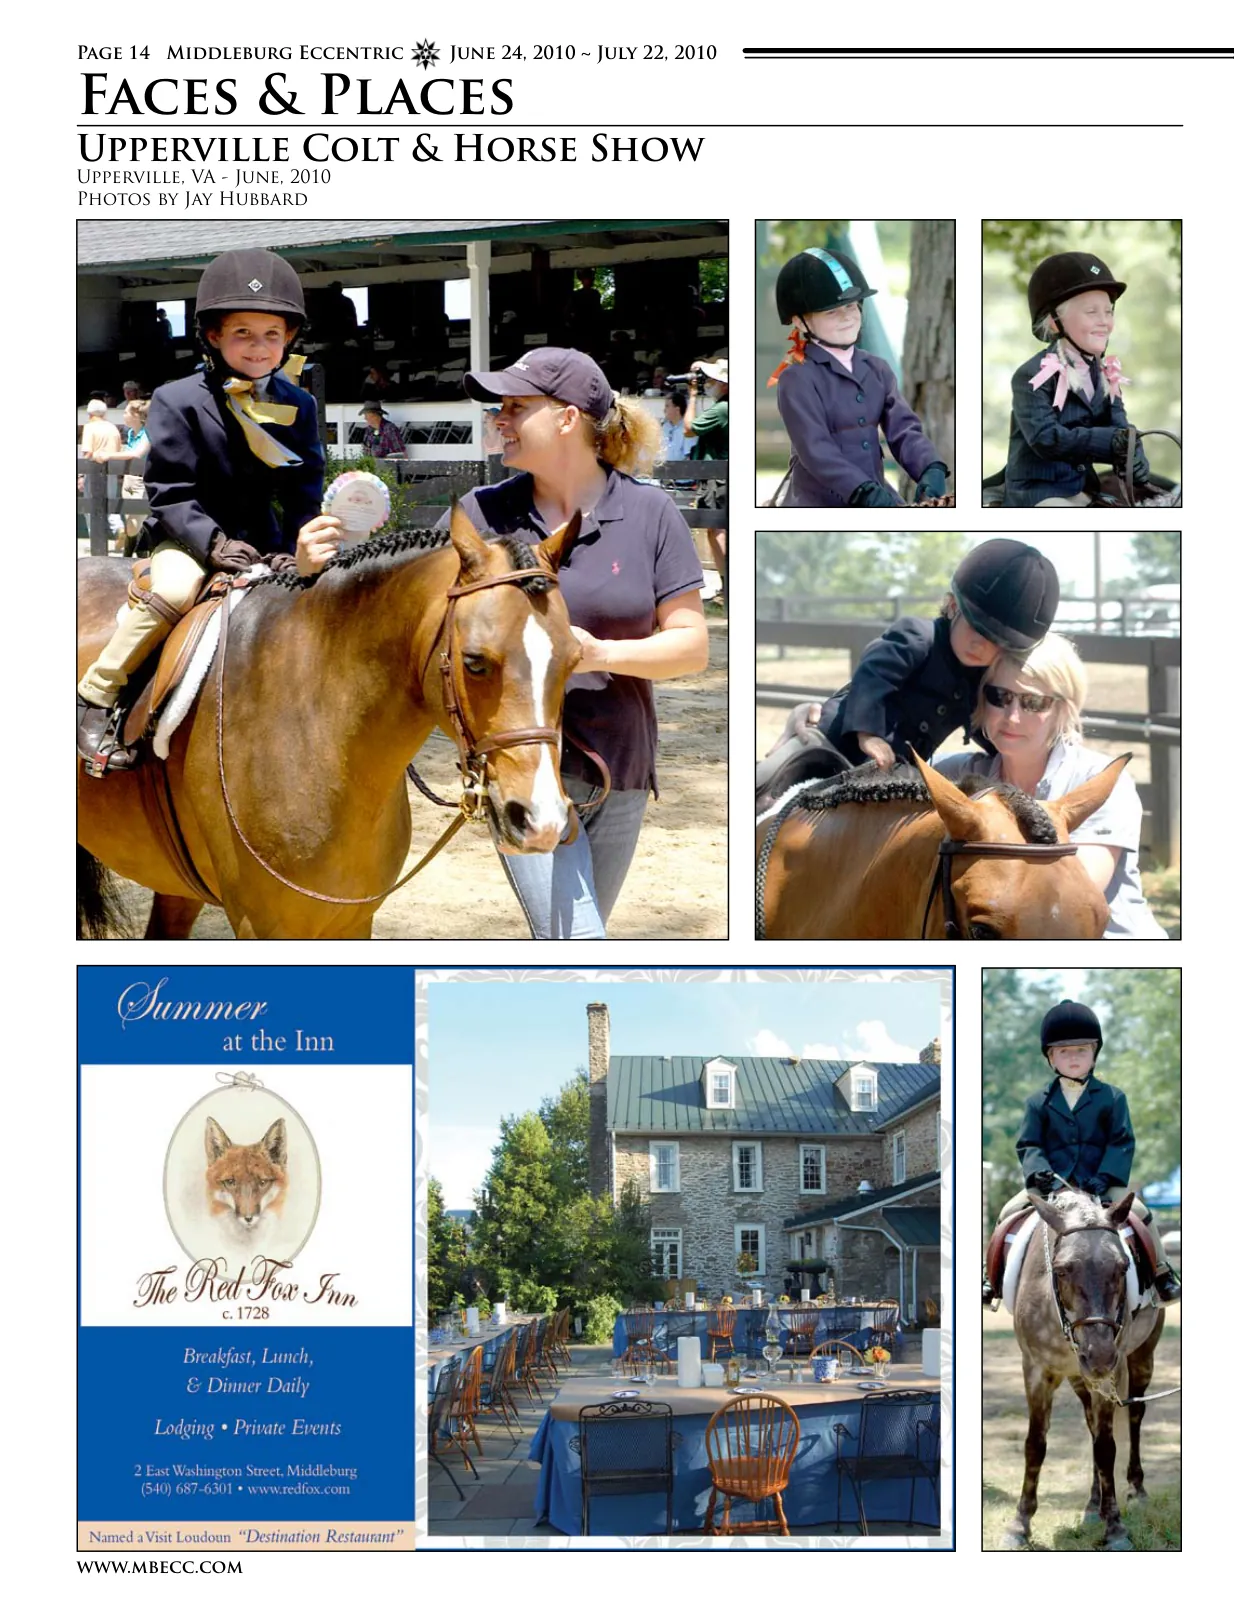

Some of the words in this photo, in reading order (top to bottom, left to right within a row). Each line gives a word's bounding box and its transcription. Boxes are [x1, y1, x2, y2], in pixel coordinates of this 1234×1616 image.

[77, 44, 123, 60] PAGE
[130, 44, 151, 60] 14
[166, 44, 293, 60] MIDDLEBURG
[299, 44, 404, 60] ECCENTRIC
[450, 44, 496, 64] JUNE
[501, 44, 527, 63] 24,
[532, 44, 576, 60] 2010
[596, 44, 638, 65] JULY
[642, 44, 668, 63] 22,
[674, 44, 717, 60] 2010
[80, 72, 238, 116] FACES
[258, 71, 306, 116] &
[320, 71, 514, 116] PLACES
[77, 133, 290, 163] UPPERVILLE
[302, 132, 400, 163] COLT
[411, 132, 444, 163] &
[453, 133, 577, 163] HORSE
[591, 132, 706, 163] SHOW
[77, 168, 186, 188] UPPERVILLE,
[191, 168, 216, 184] VA
[235, 168, 285, 188] JUNE,
[290, 168, 332, 184] 2010
[77, 190, 151, 207] PHOTOS
[159, 191, 179, 207] BY
[184, 190, 214, 210] JAY
[219, 190, 308, 207] HUBBARD
[117, 977, 269, 1031] Summer
[222, 1033, 243, 1052] at
[250, 1028, 287, 1052] the
[295, 1030, 335, 1052] Inn
[133, 1266, 178, 1308] The
[184, 1257, 246, 1302] Red
[246, 1254, 300, 1302] Fox
[303, 1272, 359, 1308] Inn
[222, 1310, 234, 1321] c.
[237, 1305, 270, 1321] 1728
[183, 1346, 256, 1369] Breakfast,
[261, 1347, 314, 1368] Lunch,
[186, 1376, 201, 1394] &
[207, 1376, 262, 1394] Dinner
[266, 1376, 311, 1399] Daily
[154, 1418, 215, 1440] Lodging
[233, 1418, 286, 1436] Private
[291, 1418, 342, 1436] Events
[133, 1464, 143, 1478] 2
[145, 1464, 170, 1478] East
[172, 1463, 243, 1481] Washington
[246, 1464, 284, 1480] Street,
[286, 1463, 358, 1481] Middleburg
[141, 1482, 172, 1498] (540)
[175, 1482, 233, 1496] 687-6301
[247, 1482, 351, 1496] www.redfox.com
[89, 1530, 134, 1544] Named
[137, 1533, 144, 1544] a
[144, 1530, 173, 1544] Visit
[175, 1530, 232, 1544] Loudoun
